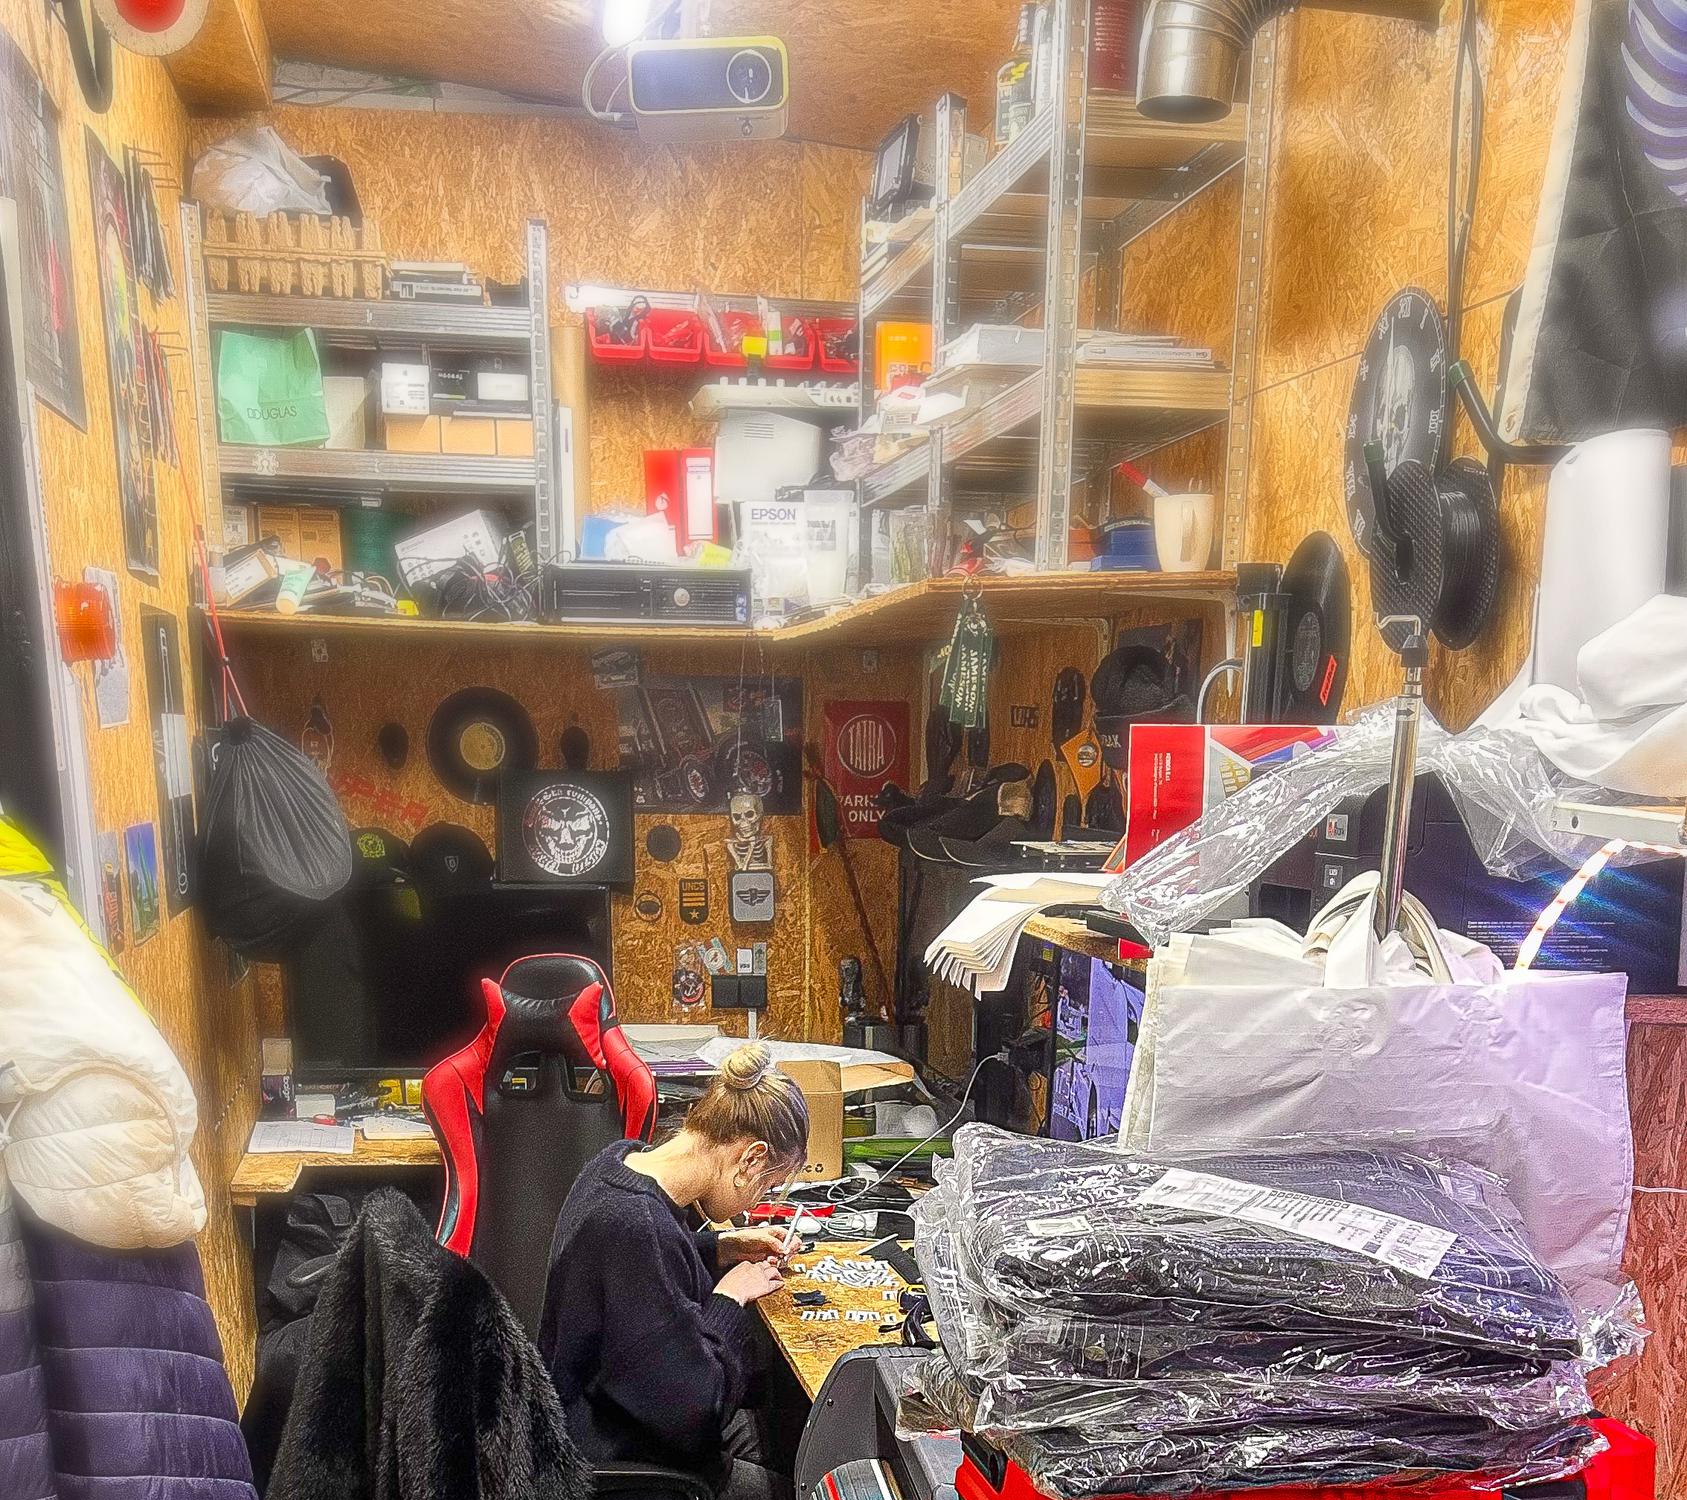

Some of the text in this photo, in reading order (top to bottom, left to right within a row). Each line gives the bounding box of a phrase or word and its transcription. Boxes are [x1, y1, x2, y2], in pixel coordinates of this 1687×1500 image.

[246, 405, 298, 420] DOUGLAS
[751, 508, 796, 520] EPSON
[849, 720, 885, 772] TATRA
[848, 810, 886, 823] ONLY
